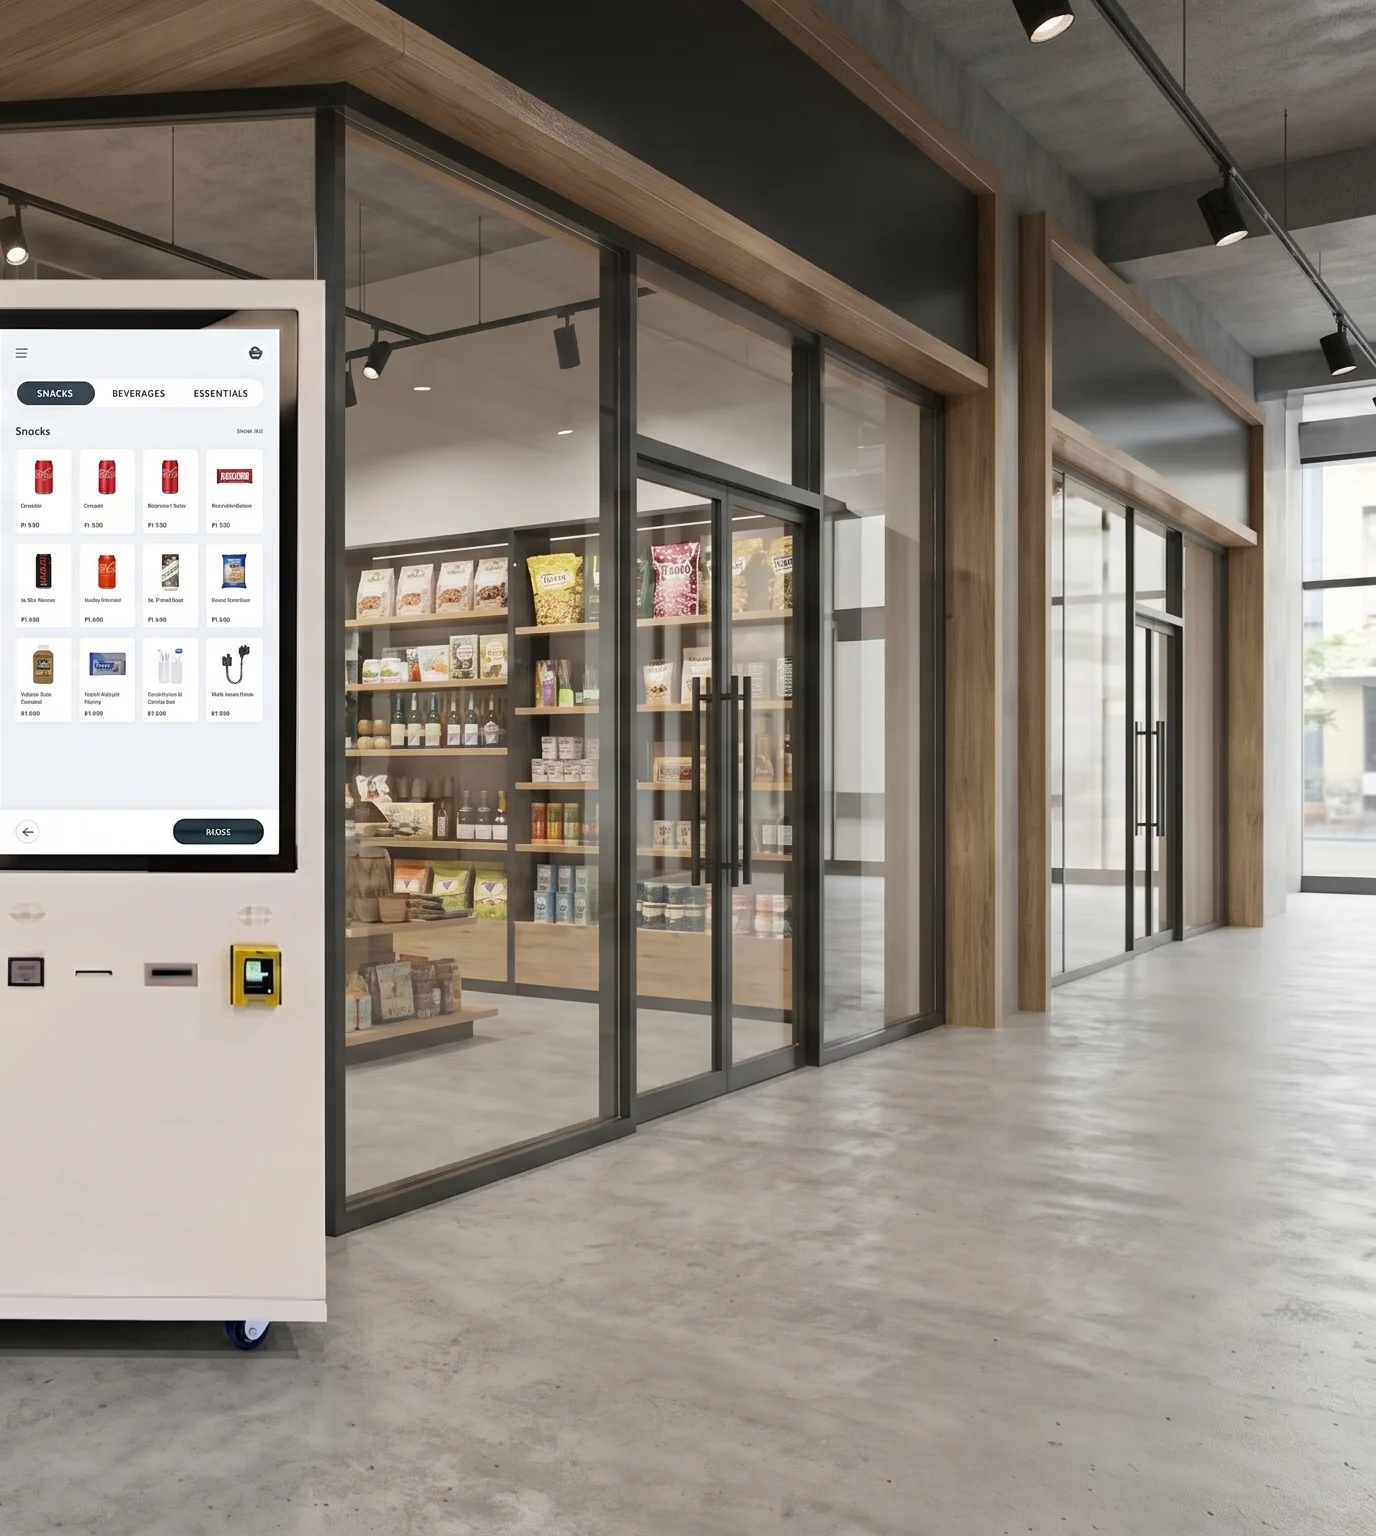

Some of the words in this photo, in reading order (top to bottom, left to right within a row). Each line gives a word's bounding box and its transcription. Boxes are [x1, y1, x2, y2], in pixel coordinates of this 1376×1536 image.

[36, 389, 73, 398] SNACKS
[112, 389, 166, 398] BEVERAGES
[193, 389, 248, 398] ESSENTIALS
[15, 426, 51, 436] Snacks
